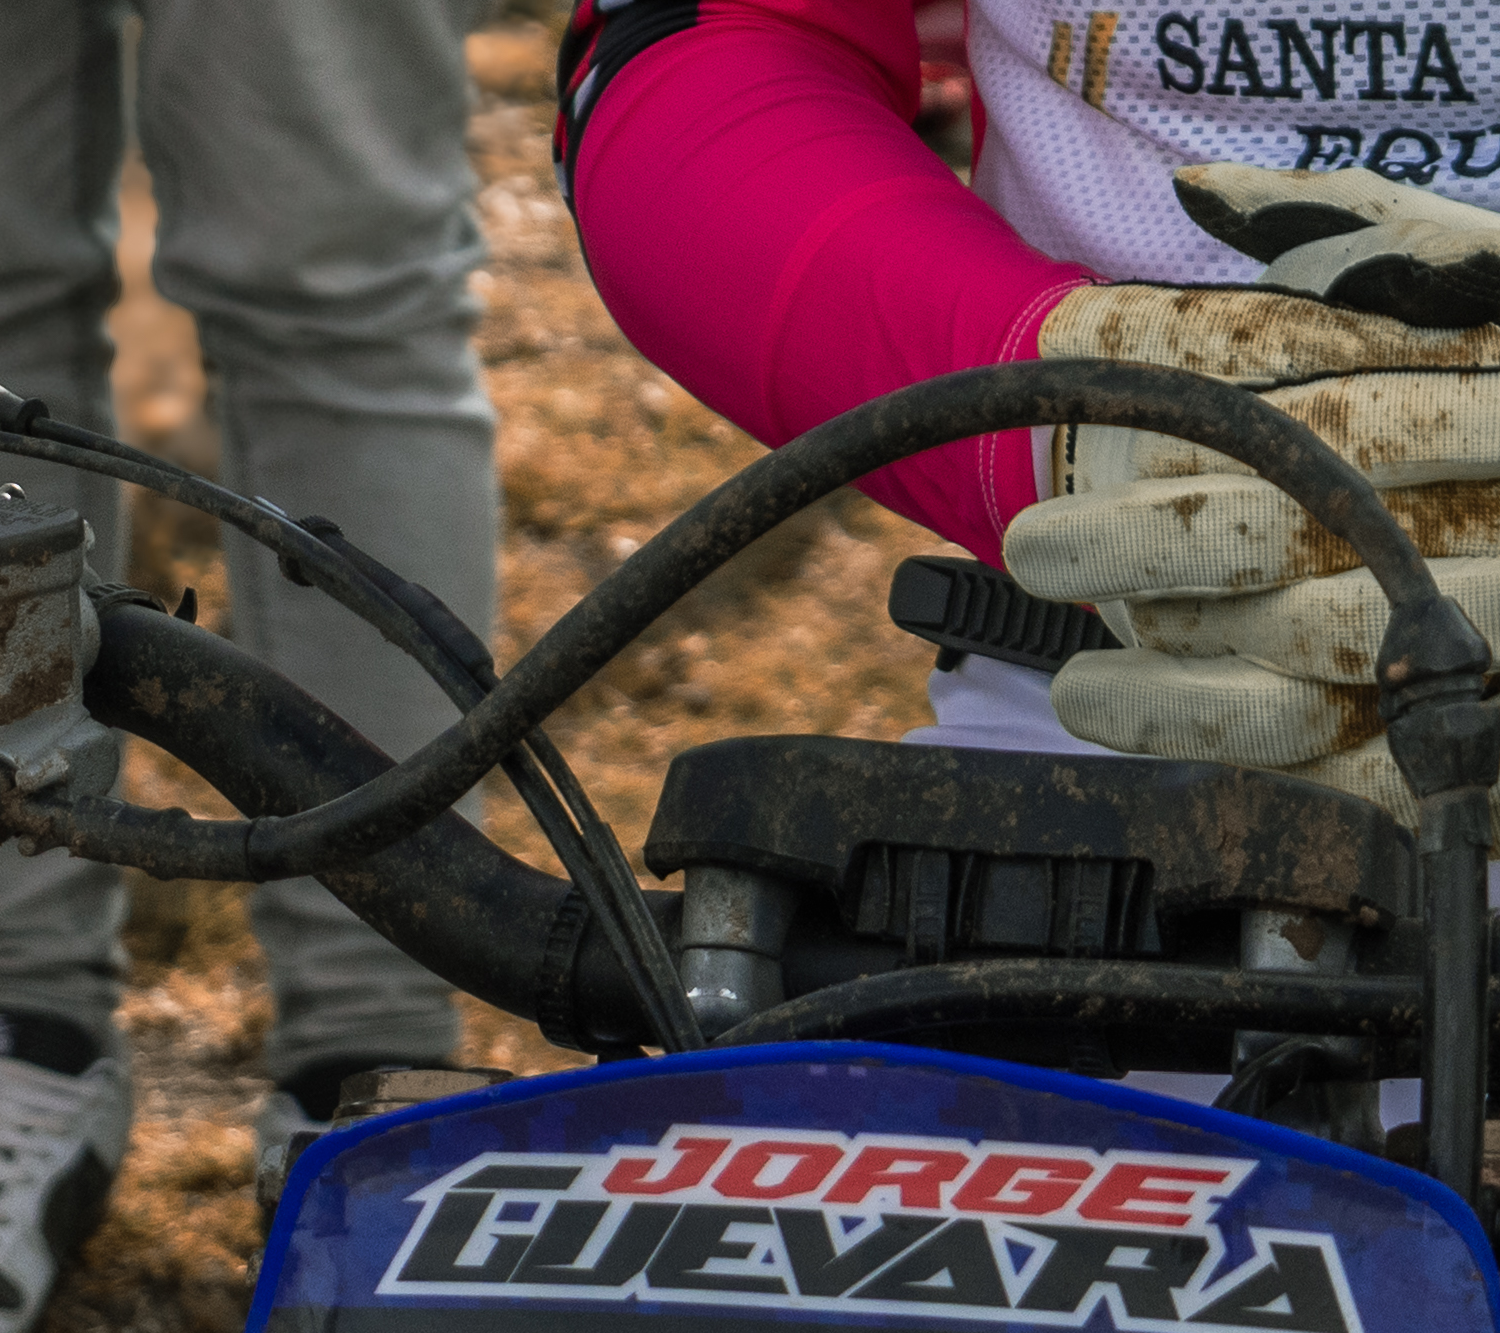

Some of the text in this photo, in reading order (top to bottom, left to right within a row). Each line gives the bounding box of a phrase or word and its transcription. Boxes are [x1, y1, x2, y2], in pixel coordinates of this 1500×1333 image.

[1155, 12, 1476, 103] SANTA
[601, 1136, 1227, 1227] JORGE
[393, 1164, 1351, 1333] GUEVARA
